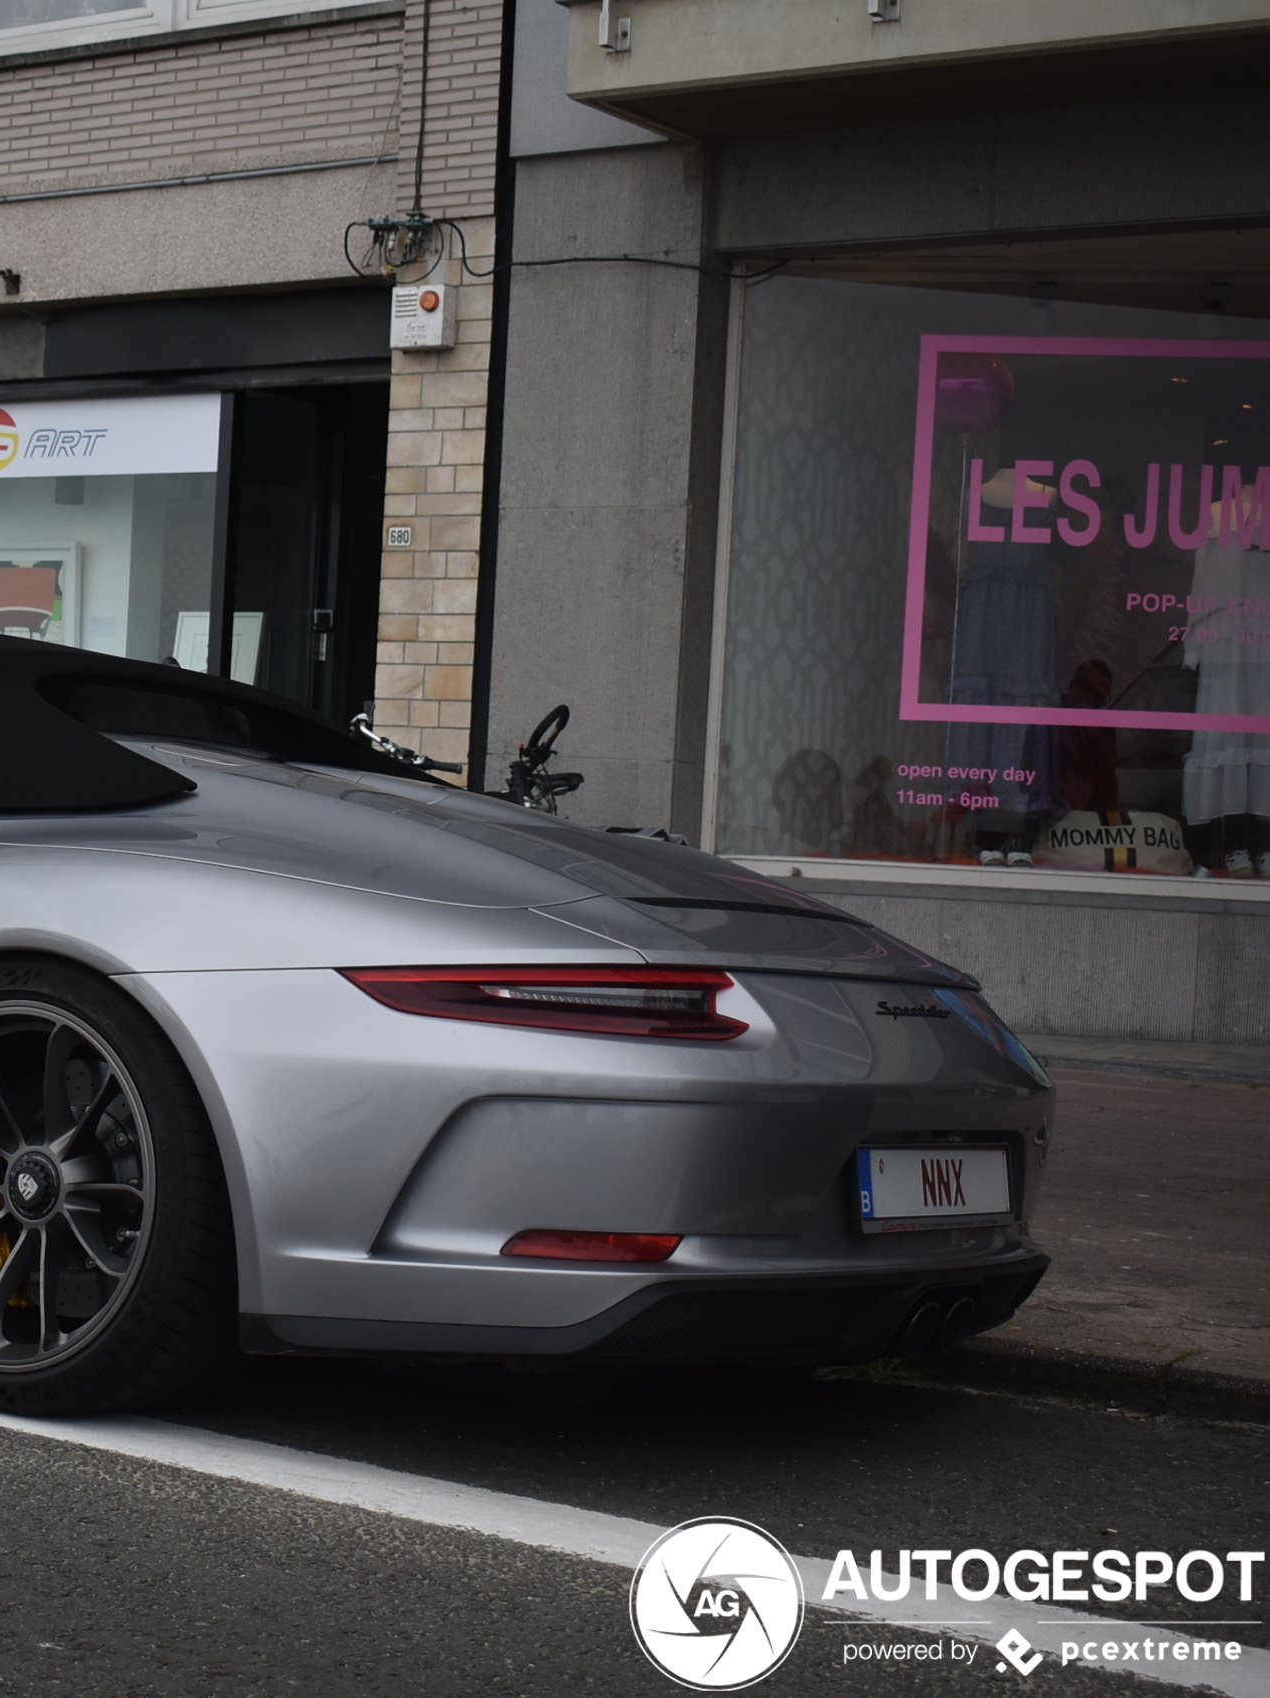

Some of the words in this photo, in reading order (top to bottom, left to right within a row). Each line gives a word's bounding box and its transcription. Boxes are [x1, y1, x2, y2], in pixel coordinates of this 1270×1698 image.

[23, 428, 108, 459] ART
[967, 458, 1102, 547] LES
[1123, 463, 1270, 550] JUM
[390, 529, 410, 544] 680
[1126, 592, 1218, 615] POP-UP
[897, 764, 943, 781] open
[947, 766, 998, 784] every
[1003, 766, 1036, 785] day
[897, 789, 943, 806] 11am
[960, 792, 1000, 811] 6pm
[1050, 827, 1137, 849] MOMMY
[1143, 827, 1181, 850] BAG
[876, 1000, 951, 1020] Speedster
[920, 1158, 966, 1207] NNX
[861, 1190, 871, 1213] B
